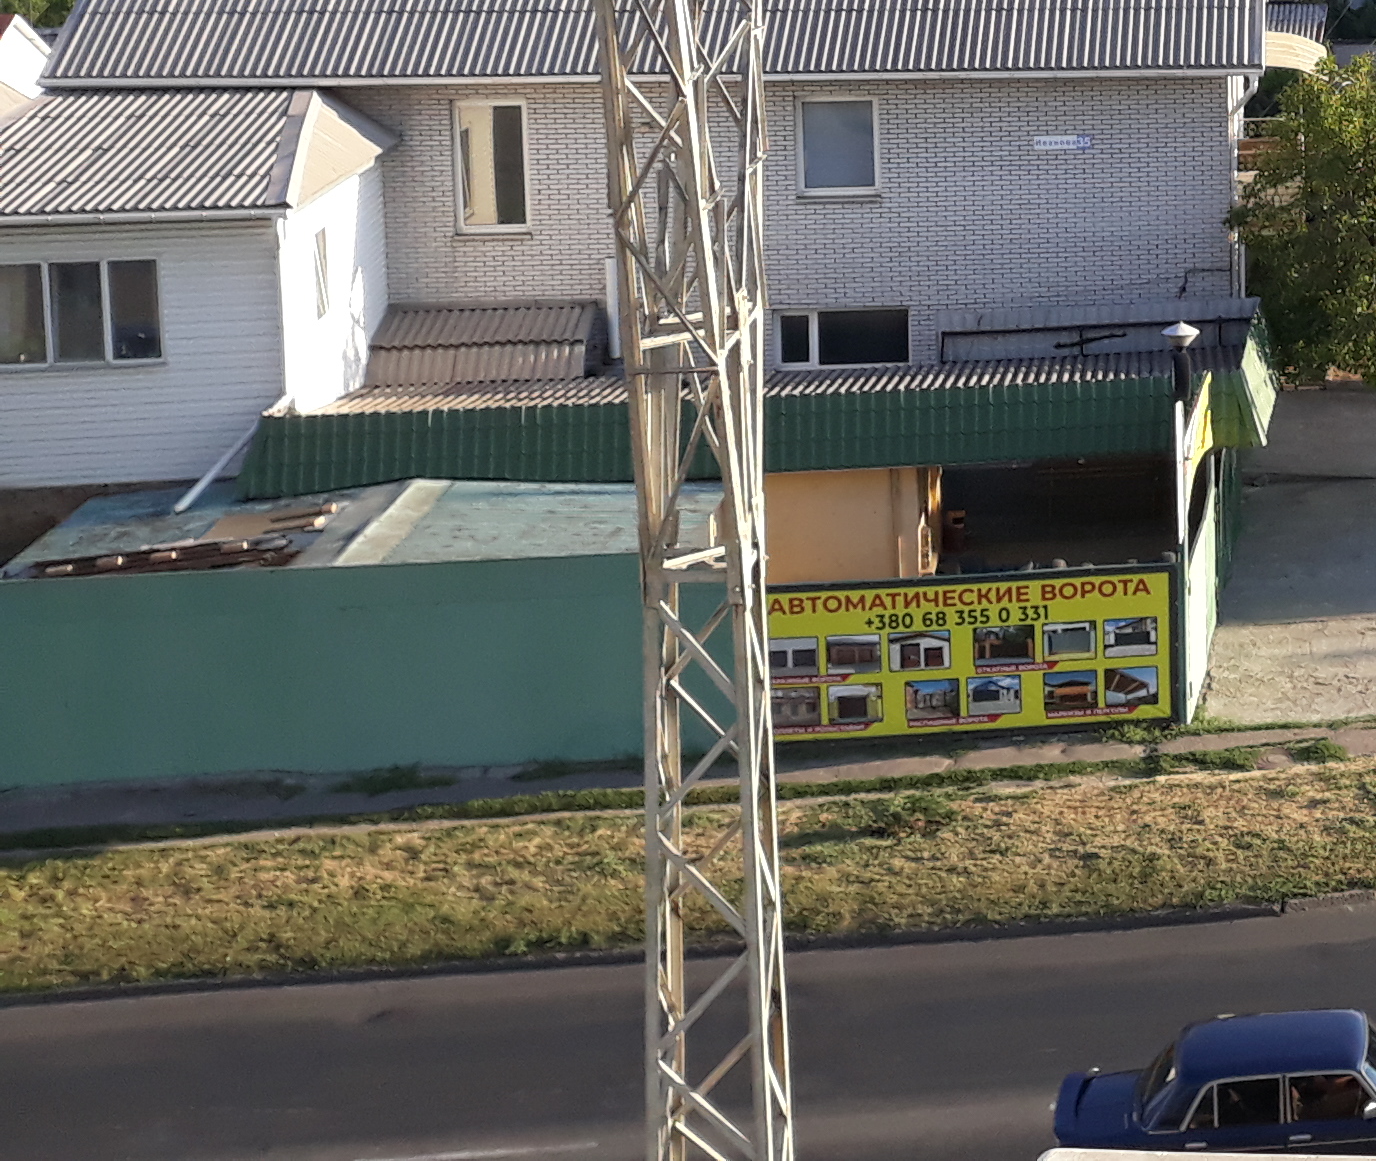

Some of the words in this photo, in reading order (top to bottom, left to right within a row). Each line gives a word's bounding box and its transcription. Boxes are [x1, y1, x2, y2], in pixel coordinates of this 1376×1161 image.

[768, 585, 1031, 616] АВТОМАТИЧЕСКИЕ
[1040, 578, 1152, 602] ВОРОТА
[864, 612, 914, 631] +380
[921, 611, 948, 628] 68
[954, 607, 991, 626] 355
[998, 606, 1011, 623] 0
[1018, 604, 1050, 622] 331
